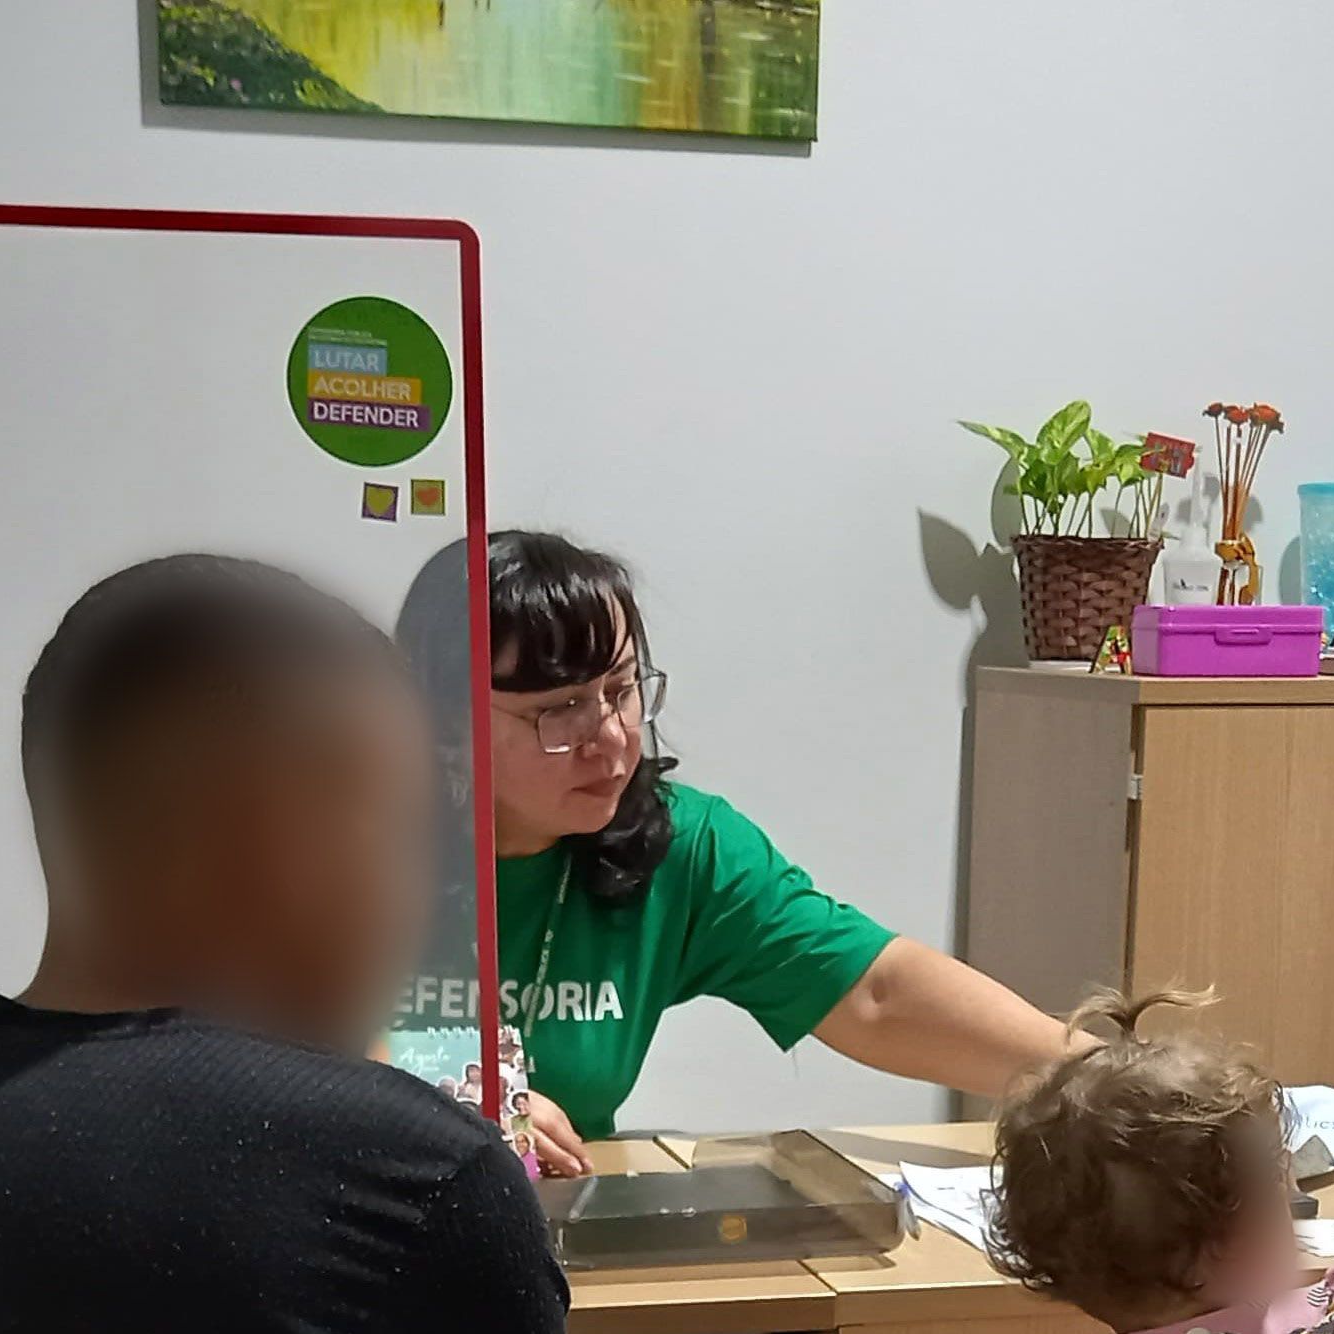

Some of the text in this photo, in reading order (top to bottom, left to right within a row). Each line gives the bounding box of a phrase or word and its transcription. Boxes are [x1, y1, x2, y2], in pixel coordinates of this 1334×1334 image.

[315, 350, 380, 372] LUTAR
[314, 376, 412, 401] ACOLHER
[313, 402, 419, 428] DEFENDER
